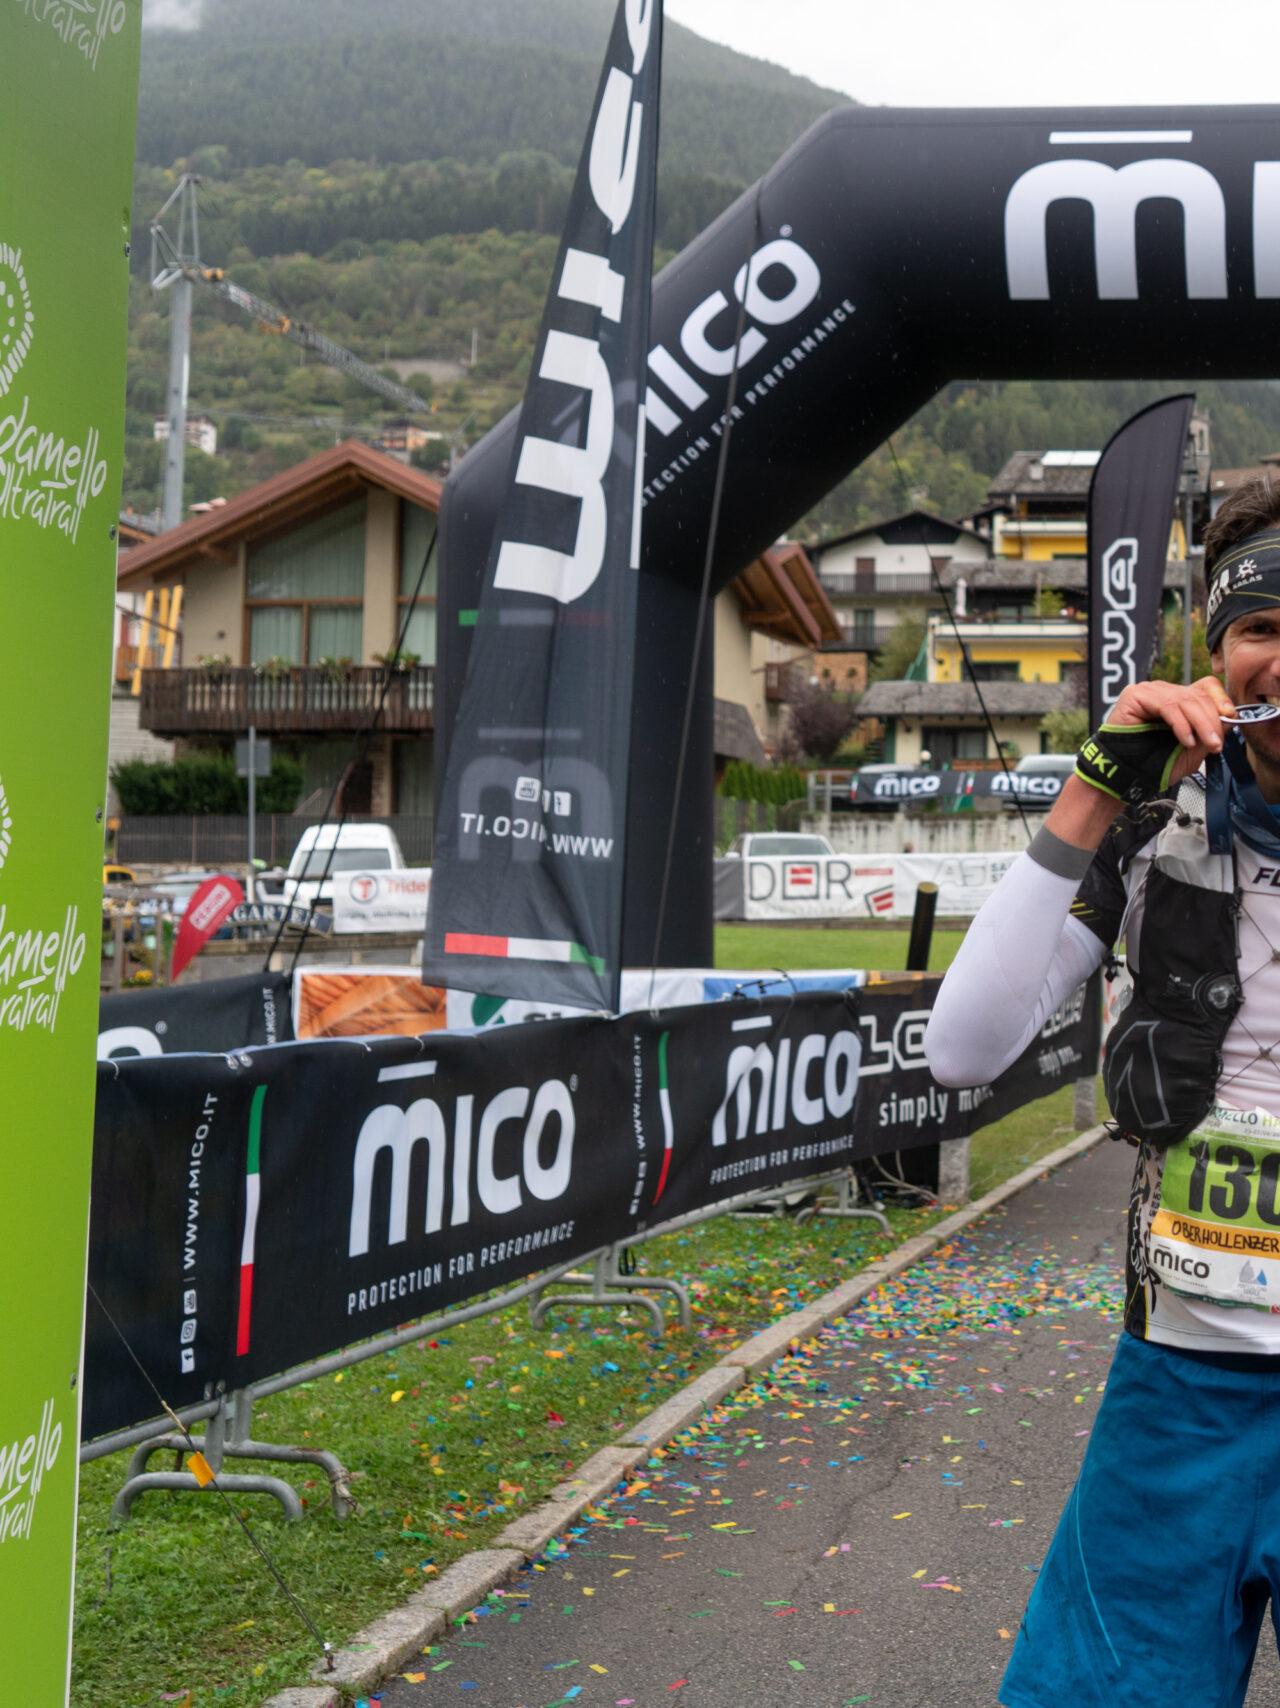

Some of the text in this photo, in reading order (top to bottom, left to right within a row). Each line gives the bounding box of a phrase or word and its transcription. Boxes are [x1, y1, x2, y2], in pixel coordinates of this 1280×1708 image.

[744, 298, 858, 406] PERFORMANCE
[878, 1086, 949, 1128] simply
[183, 1093, 219, 1271] WWW.MICO.IT
[769, 1149, 789, 1168] FOR
[347, 1219, 576, 1316] PROTECTION FOR PERFORMANCE
